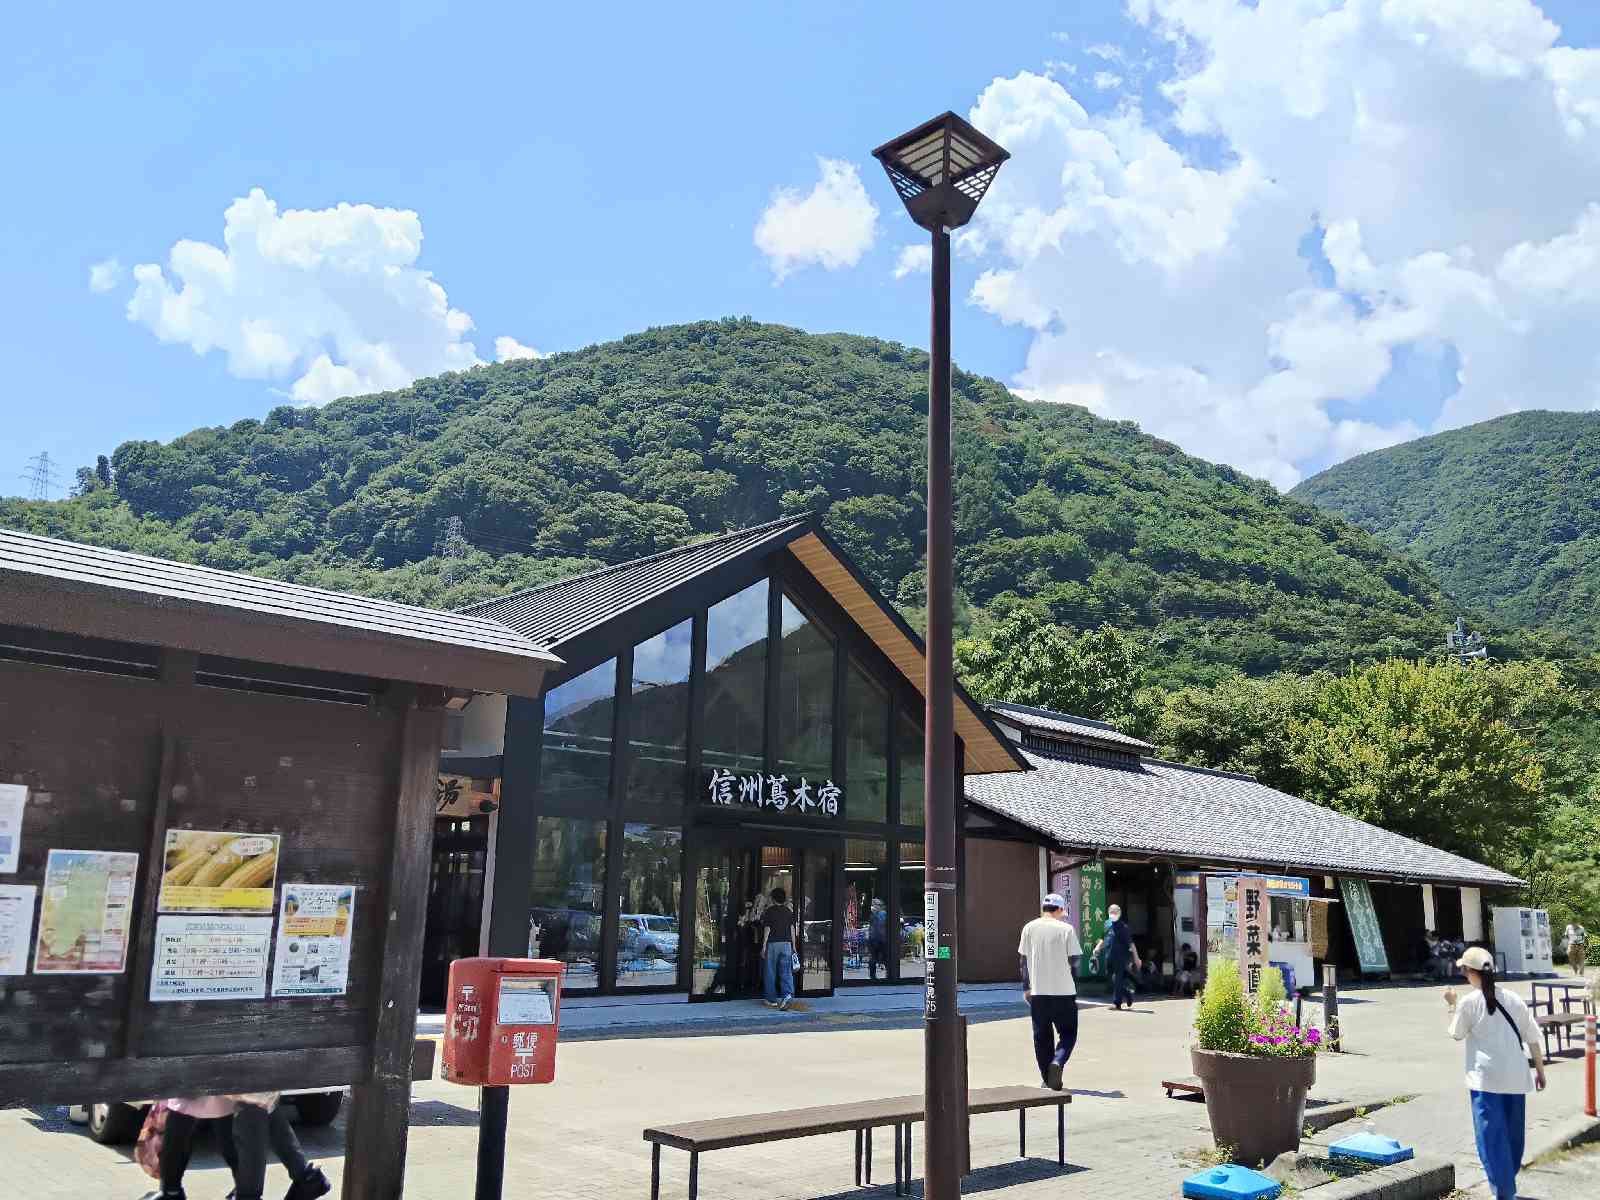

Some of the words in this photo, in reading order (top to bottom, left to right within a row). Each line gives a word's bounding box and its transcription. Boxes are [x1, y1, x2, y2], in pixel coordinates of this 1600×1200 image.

[708, 769, 842, 816] 信州蔦木宿
[512, 1032, 538, 1048] 郵便
[511, 1063, 536, 1078] POST
